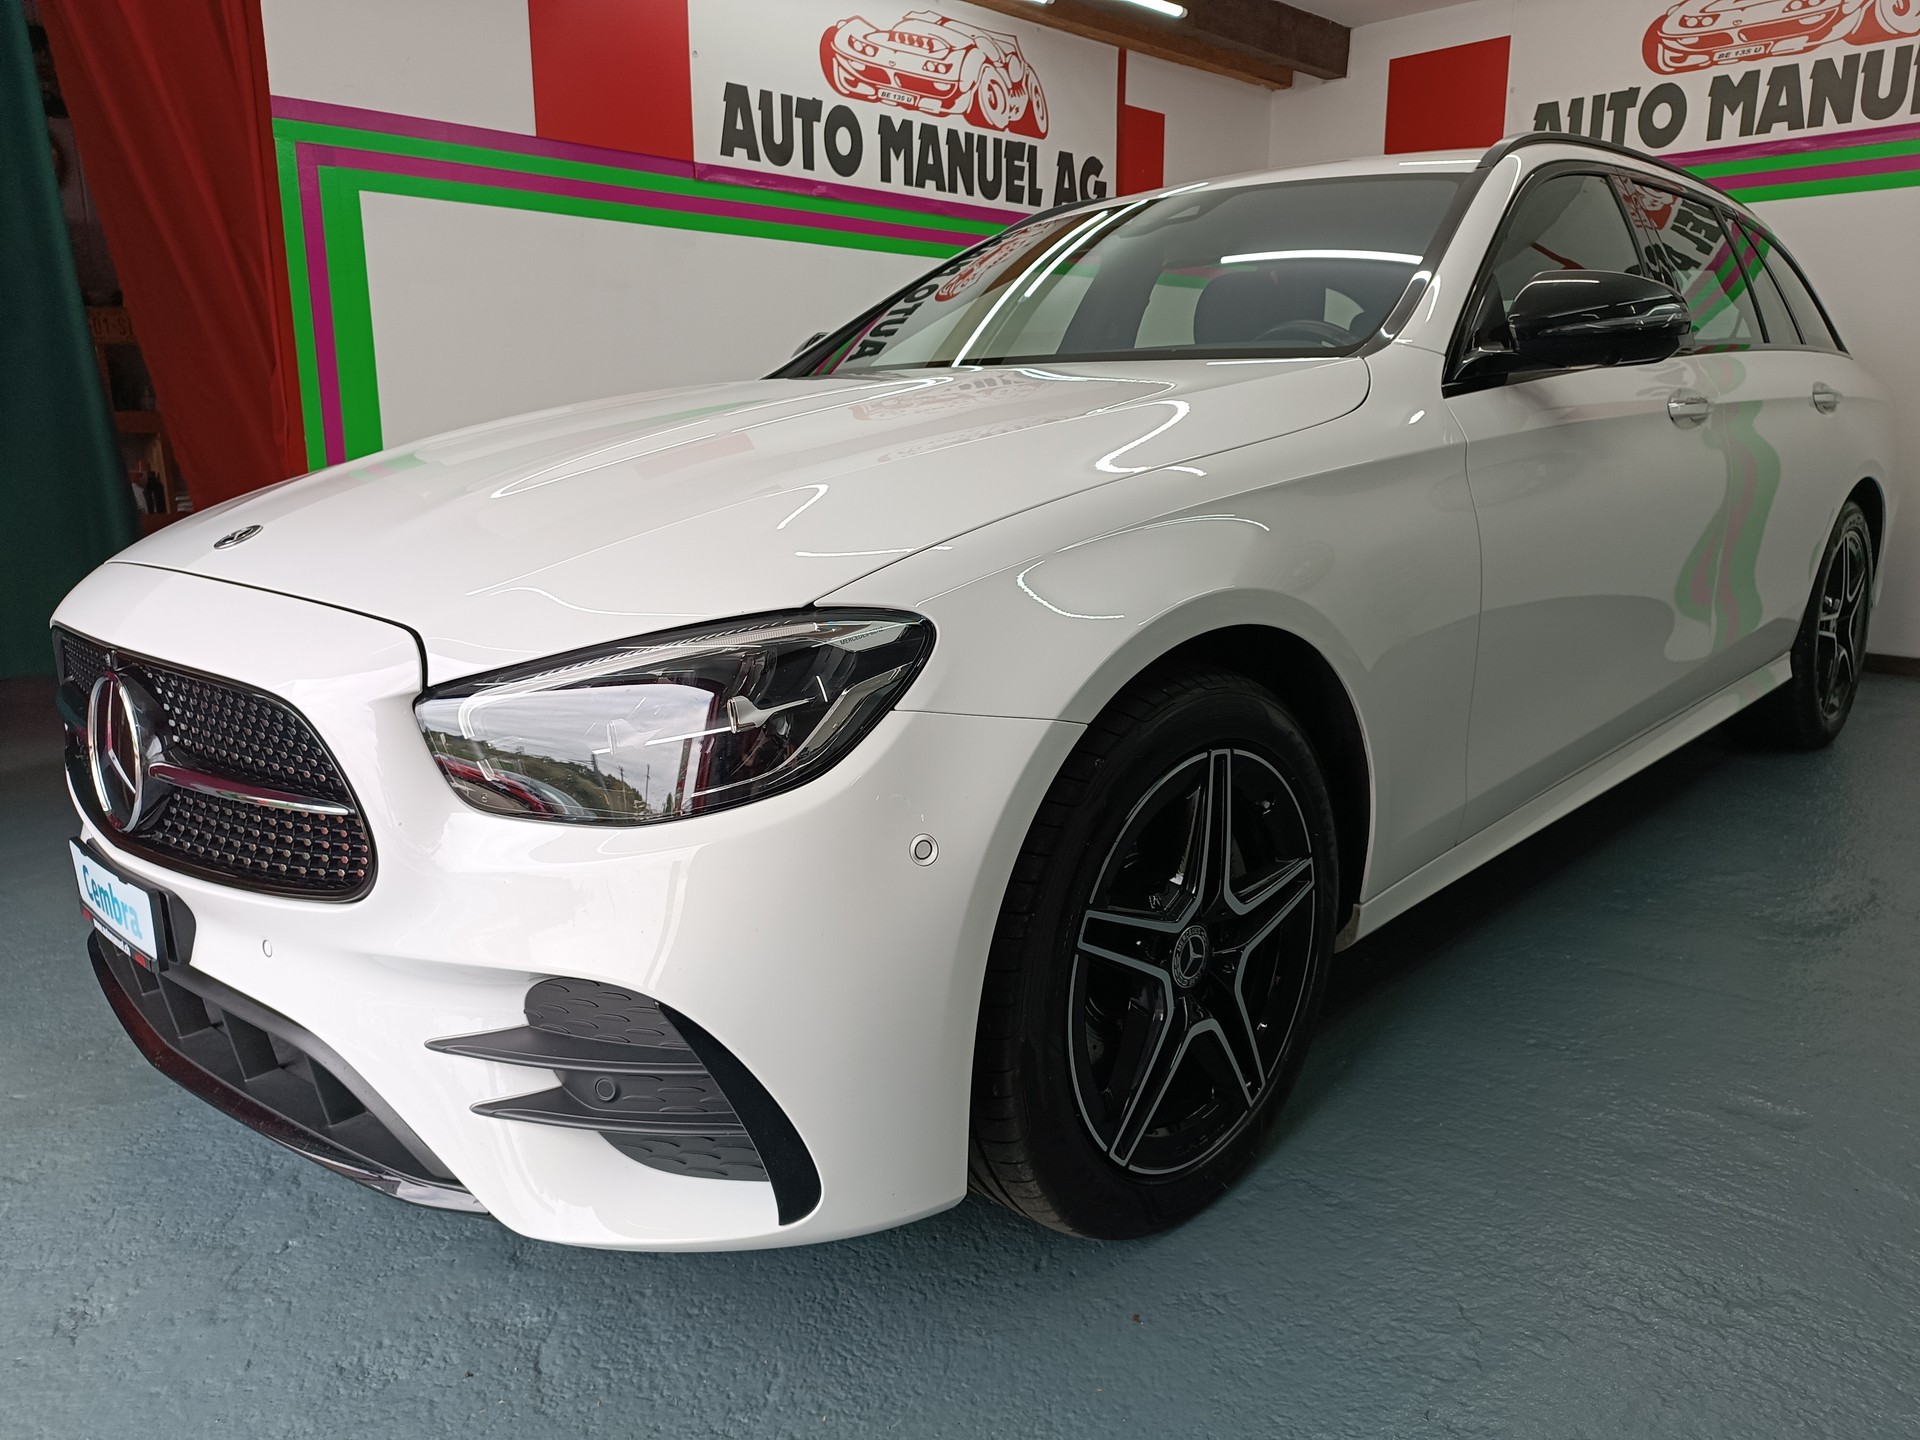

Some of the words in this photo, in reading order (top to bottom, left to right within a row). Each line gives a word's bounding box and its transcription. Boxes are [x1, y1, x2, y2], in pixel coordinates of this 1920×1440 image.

[1734, 48, 1752, 57] 135
[719, 82, 864, 178] AUTO
[877, 114, 1043, 208] MANUEL
[1053, 150, 1108, 207] AG
[82, 864, 143, 940] Cembra
